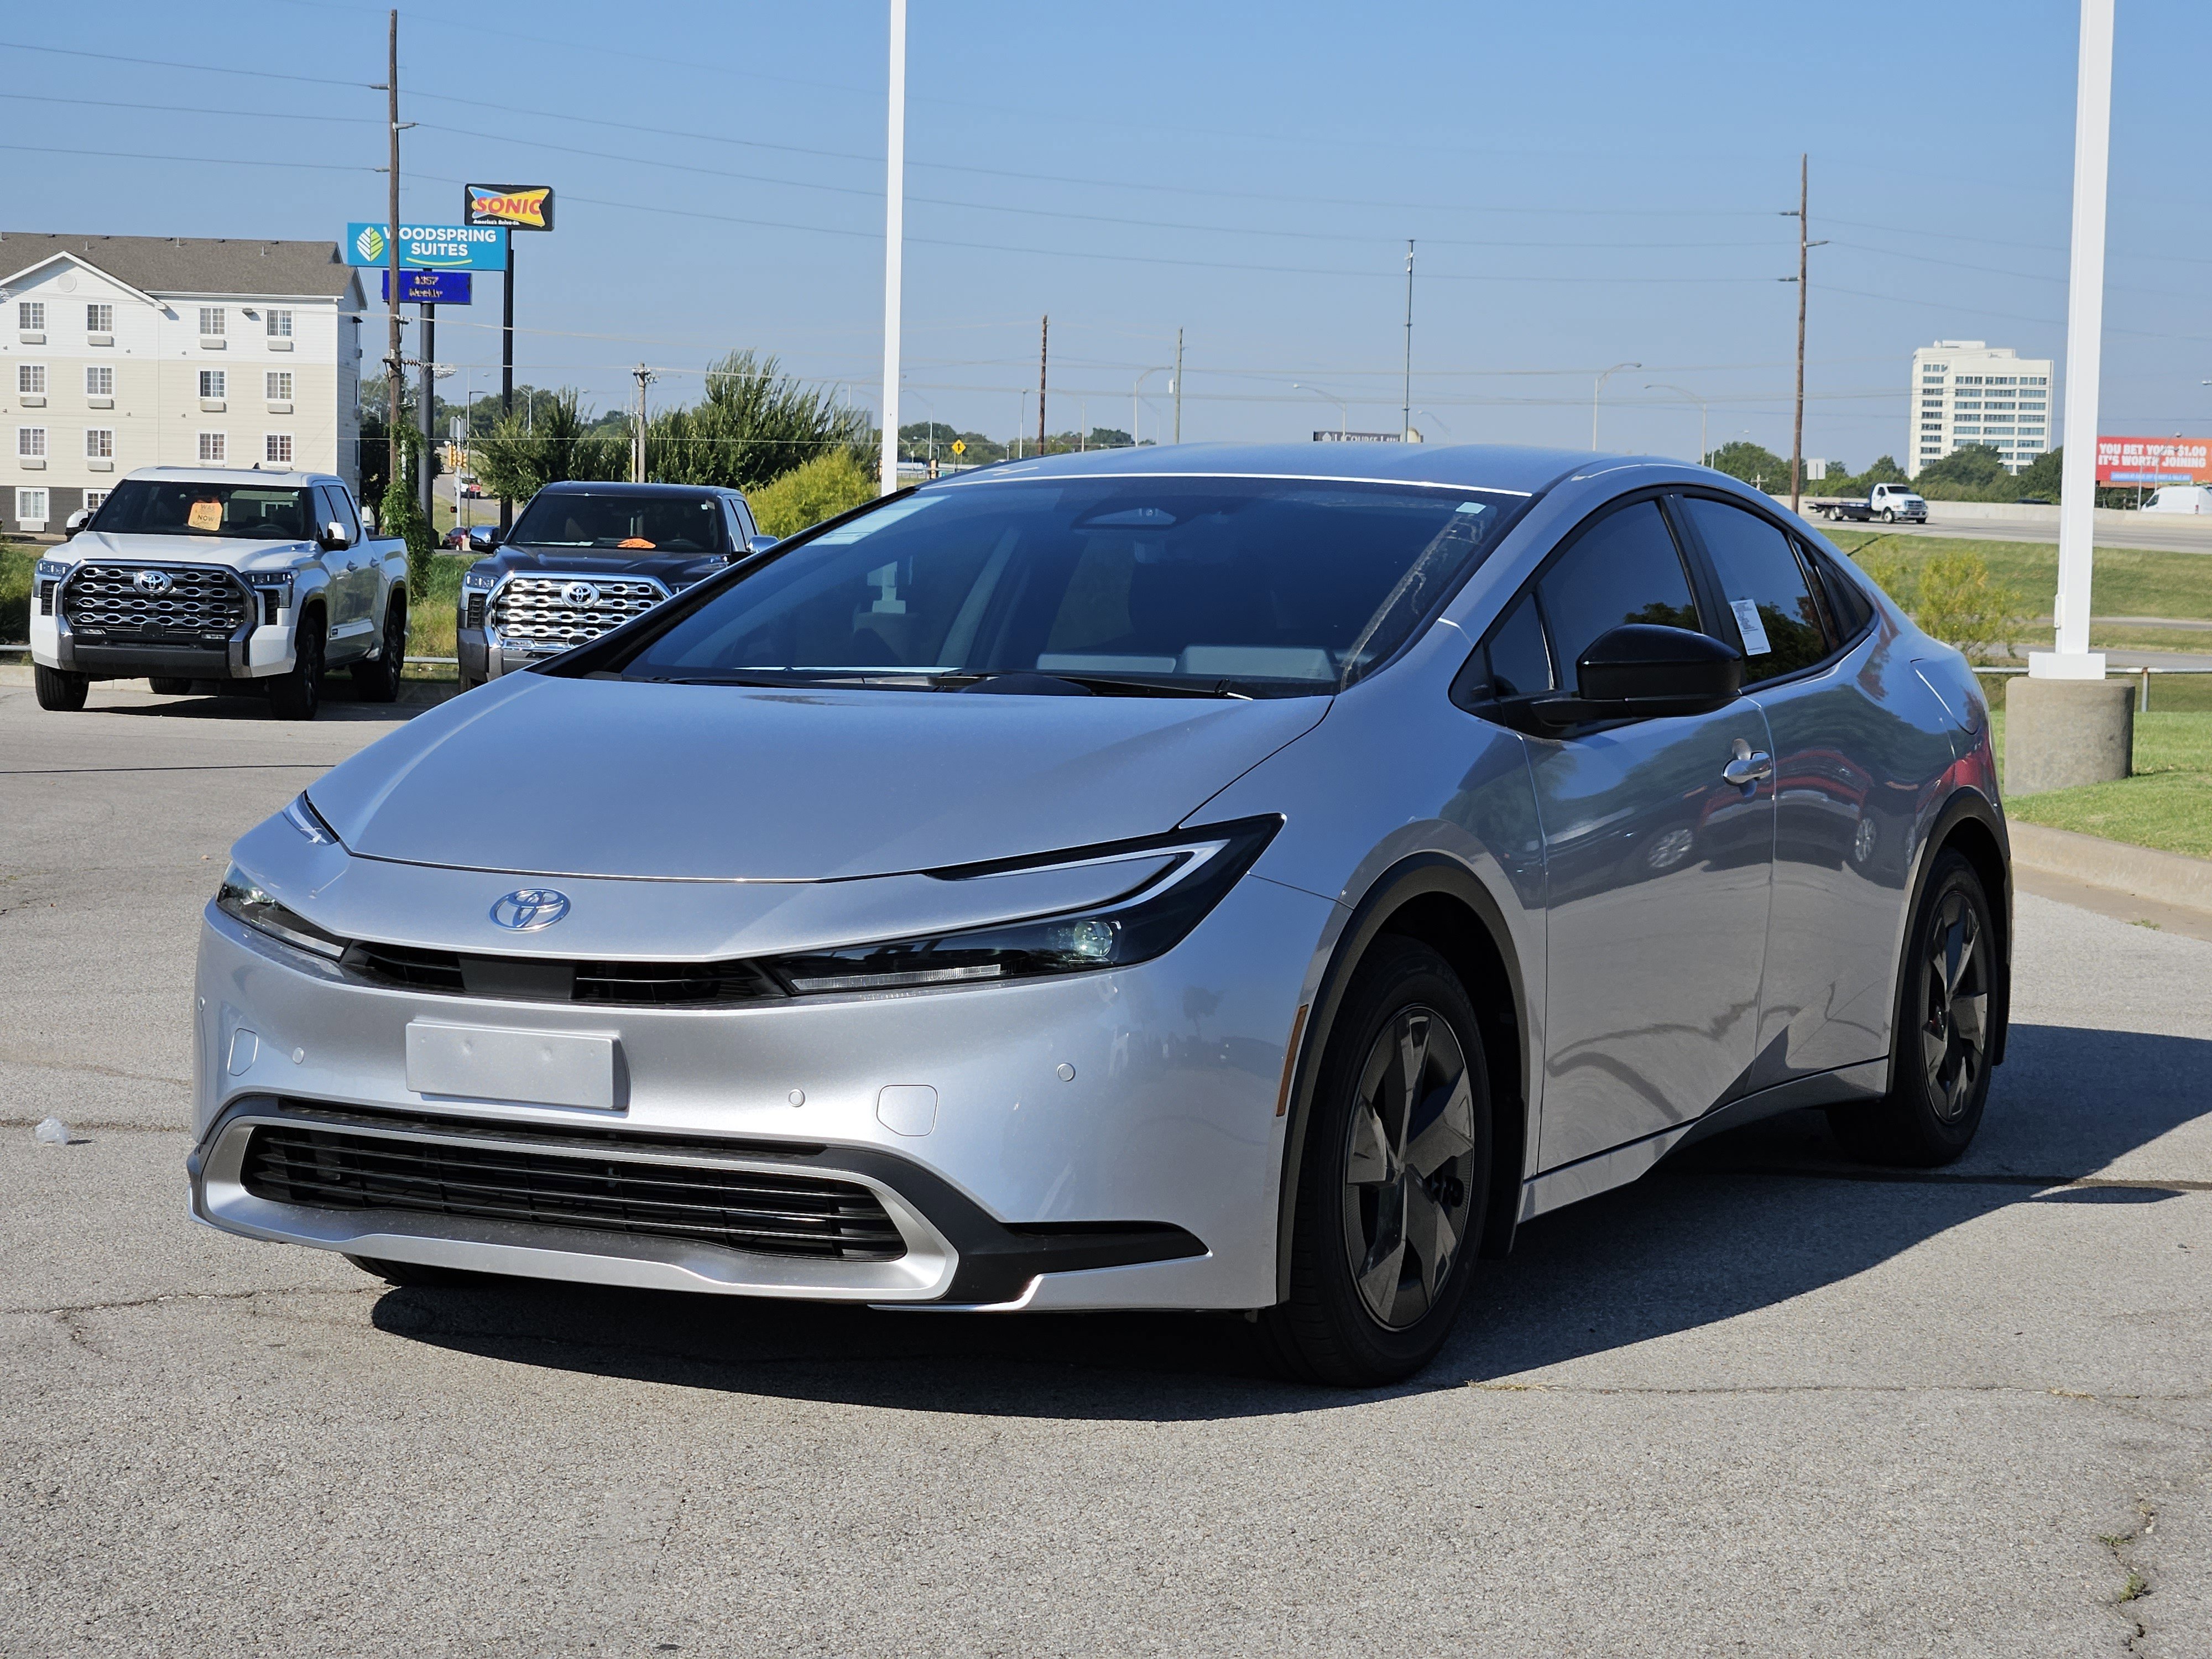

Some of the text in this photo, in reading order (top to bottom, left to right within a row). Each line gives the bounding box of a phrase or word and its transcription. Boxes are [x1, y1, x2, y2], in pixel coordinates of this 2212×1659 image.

[476, 197, 542, 215] SONIC
[411, 242, 468, 256] SUITES
[2099, 444, 2206, 457] YOU BET YOUR $1.00
[2098, 455, 2206, 467] IT'S WORTH JOINING
